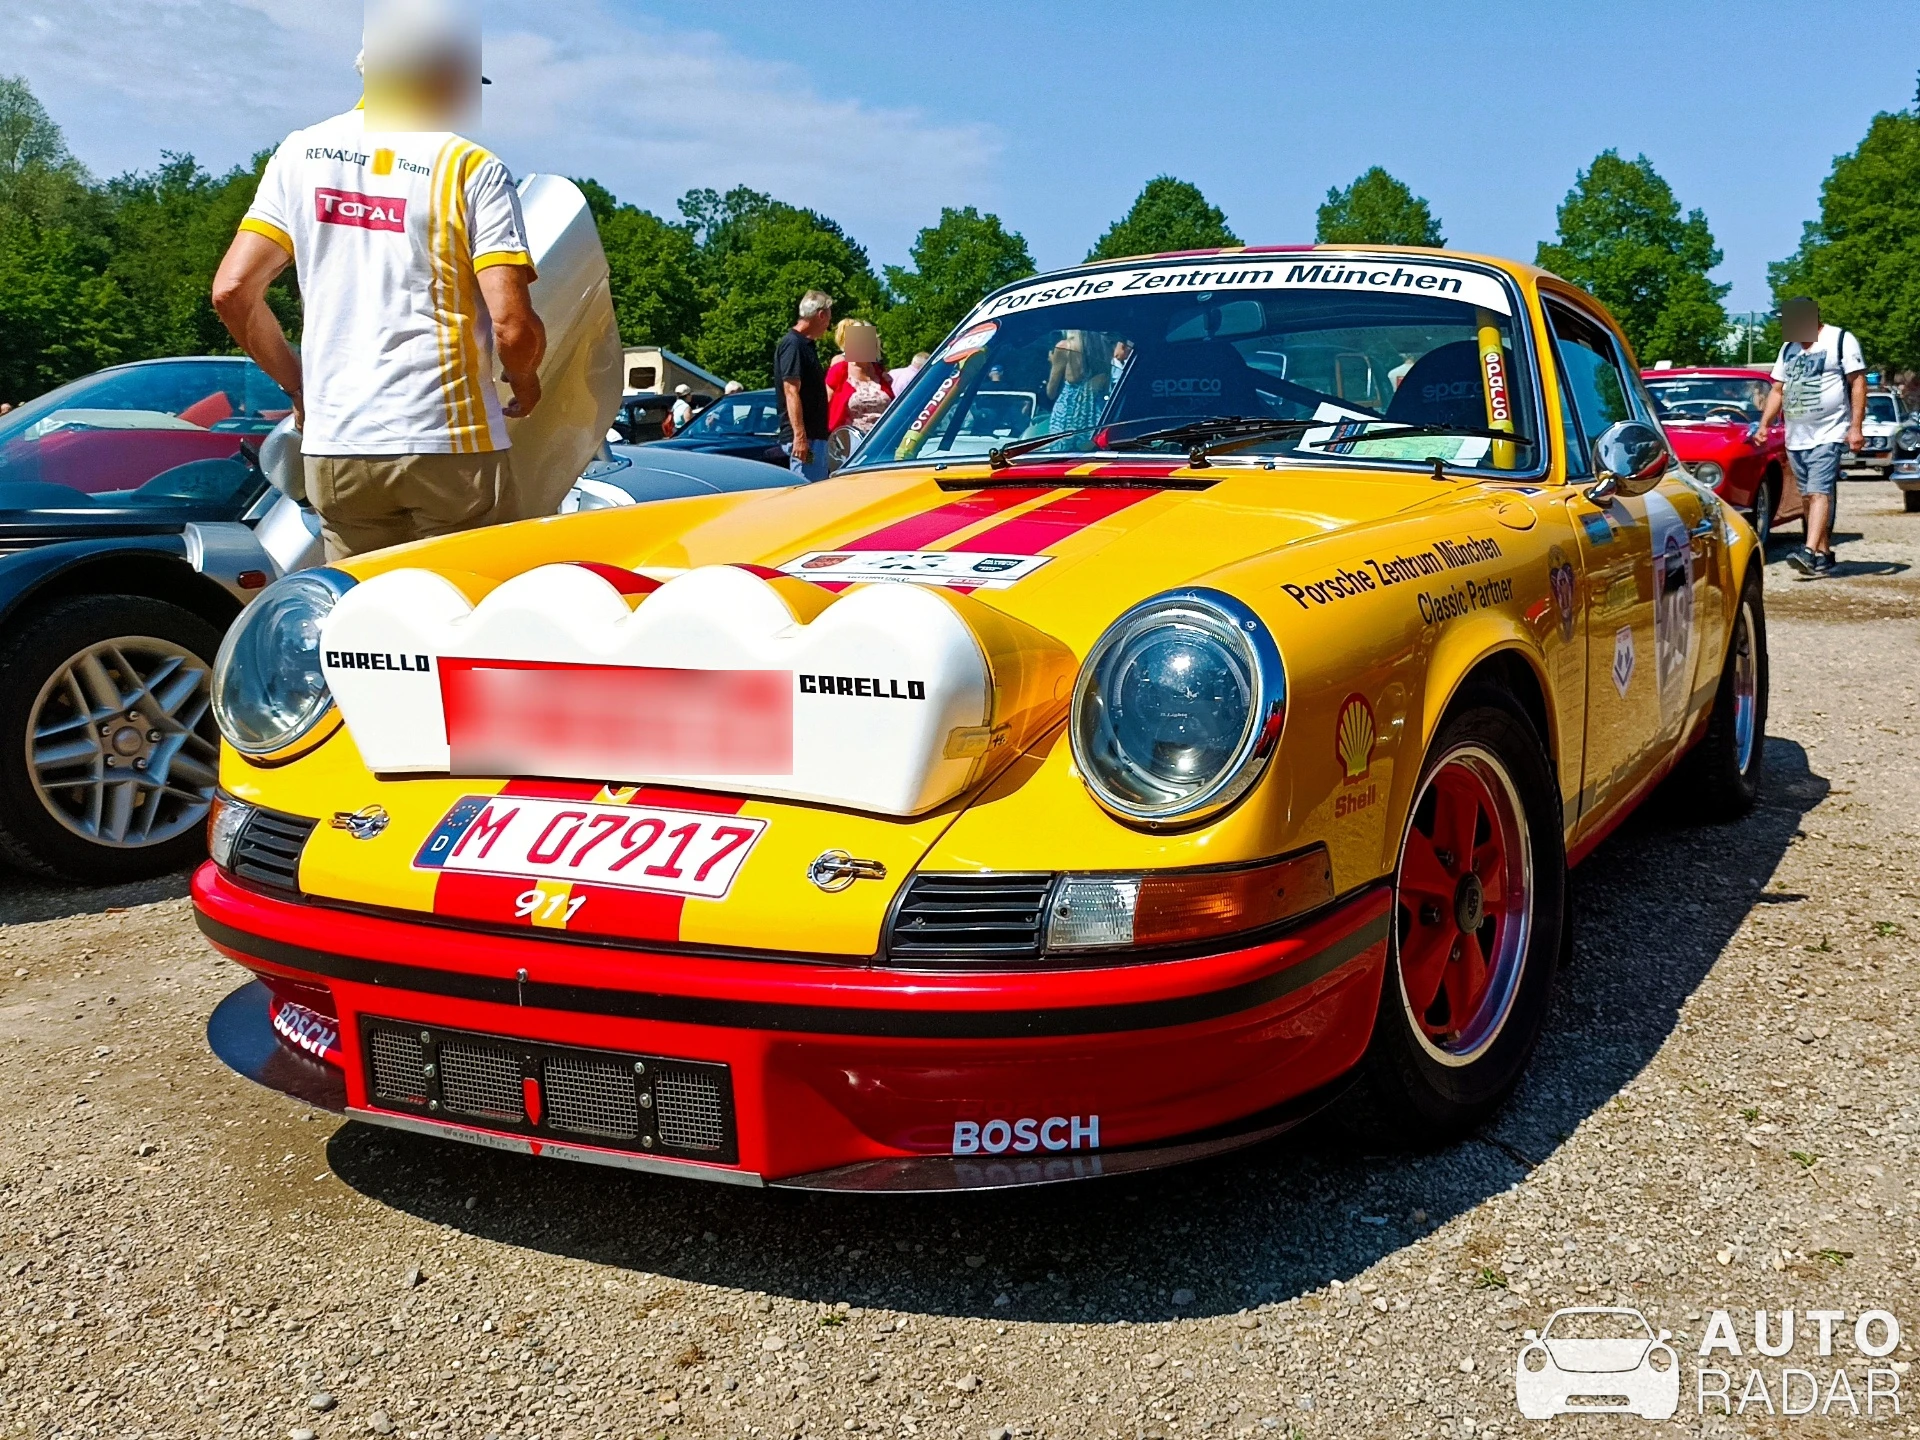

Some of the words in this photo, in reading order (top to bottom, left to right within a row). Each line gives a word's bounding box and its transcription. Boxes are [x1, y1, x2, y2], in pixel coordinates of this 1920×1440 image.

[305, 147, 370, 167] RENAULT
[397, 158, 431, 176] Team
[318, 193, 402, 223] TOTAL
[987, 279, 1114, 316] Porsche
[1122, 269, 1274, 292] Zentrum
[1285, 264, 1463, 294] München
[1151, 378, 1221, 398] sparco
[1485, 352, 1508, 420] sparco
[1280, 568, 1376, 610] Porsche
[1363, 549, 1444, 587] Zentrum
[1432, 535, 1503, 569] München
[1417, 585, 1468, 625] Classic
[1466, 577, 1514, 611] Partner
[325, 651, 430, 672] CARELLO
[799, 674, 926, 700] CARELLO
[1335, 784, 1376, 819] Shell
[430, 834, 449, 852] D
[452, 805, 520, 859] M
[526, 811, 756, 882] 07917
[514, 889, 587, 923] 911
[273, 1003, 337, 1058] BOSCH
[952, 1115, 1100, 1155] BOSCH
